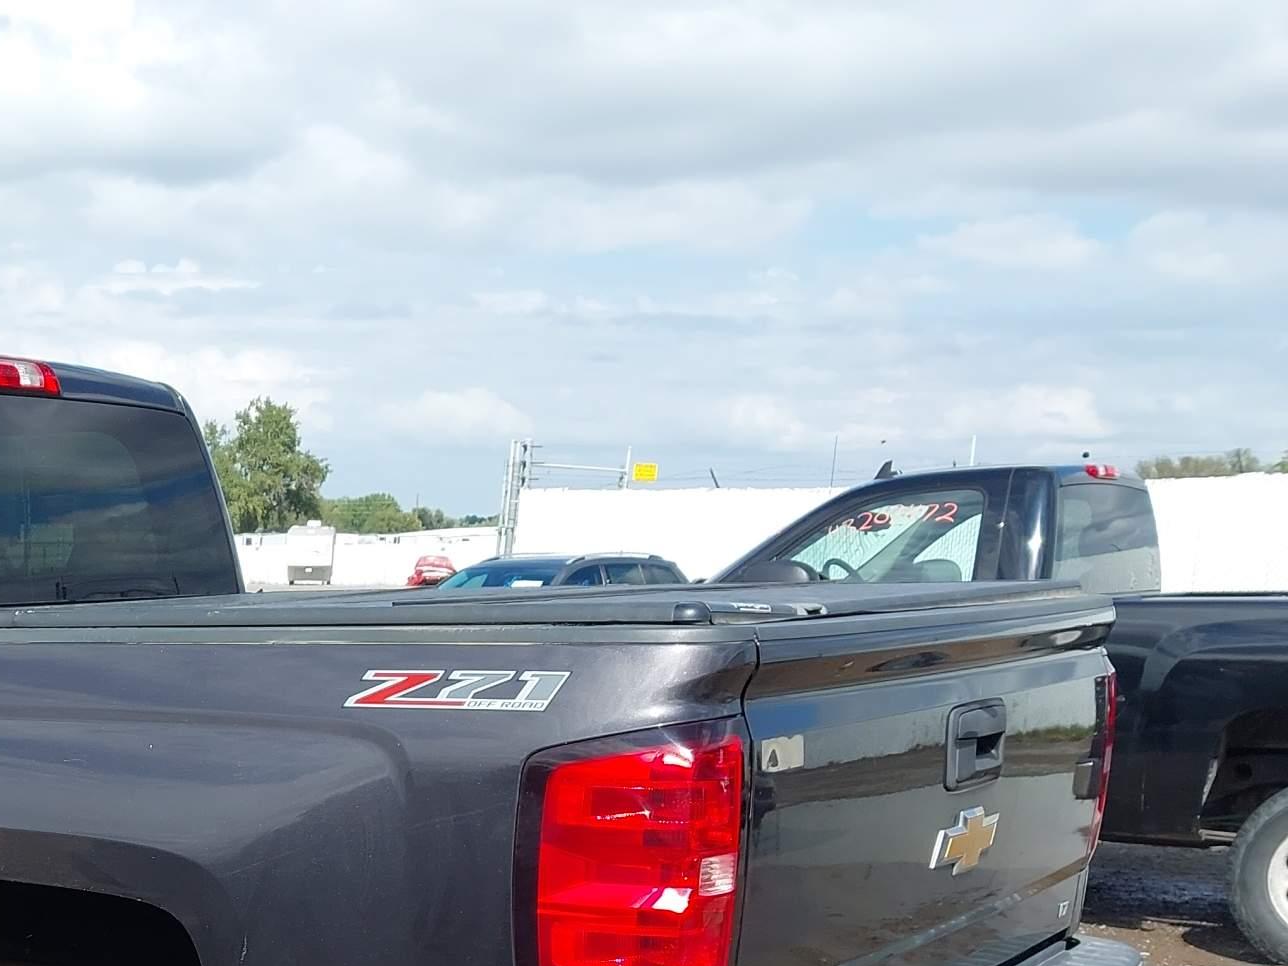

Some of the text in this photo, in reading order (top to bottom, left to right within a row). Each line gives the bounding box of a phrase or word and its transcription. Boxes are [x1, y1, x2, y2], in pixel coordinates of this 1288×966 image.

[342, 669, 572, 711] Z71
[467, 700, 546, 710] OFF ROAD
